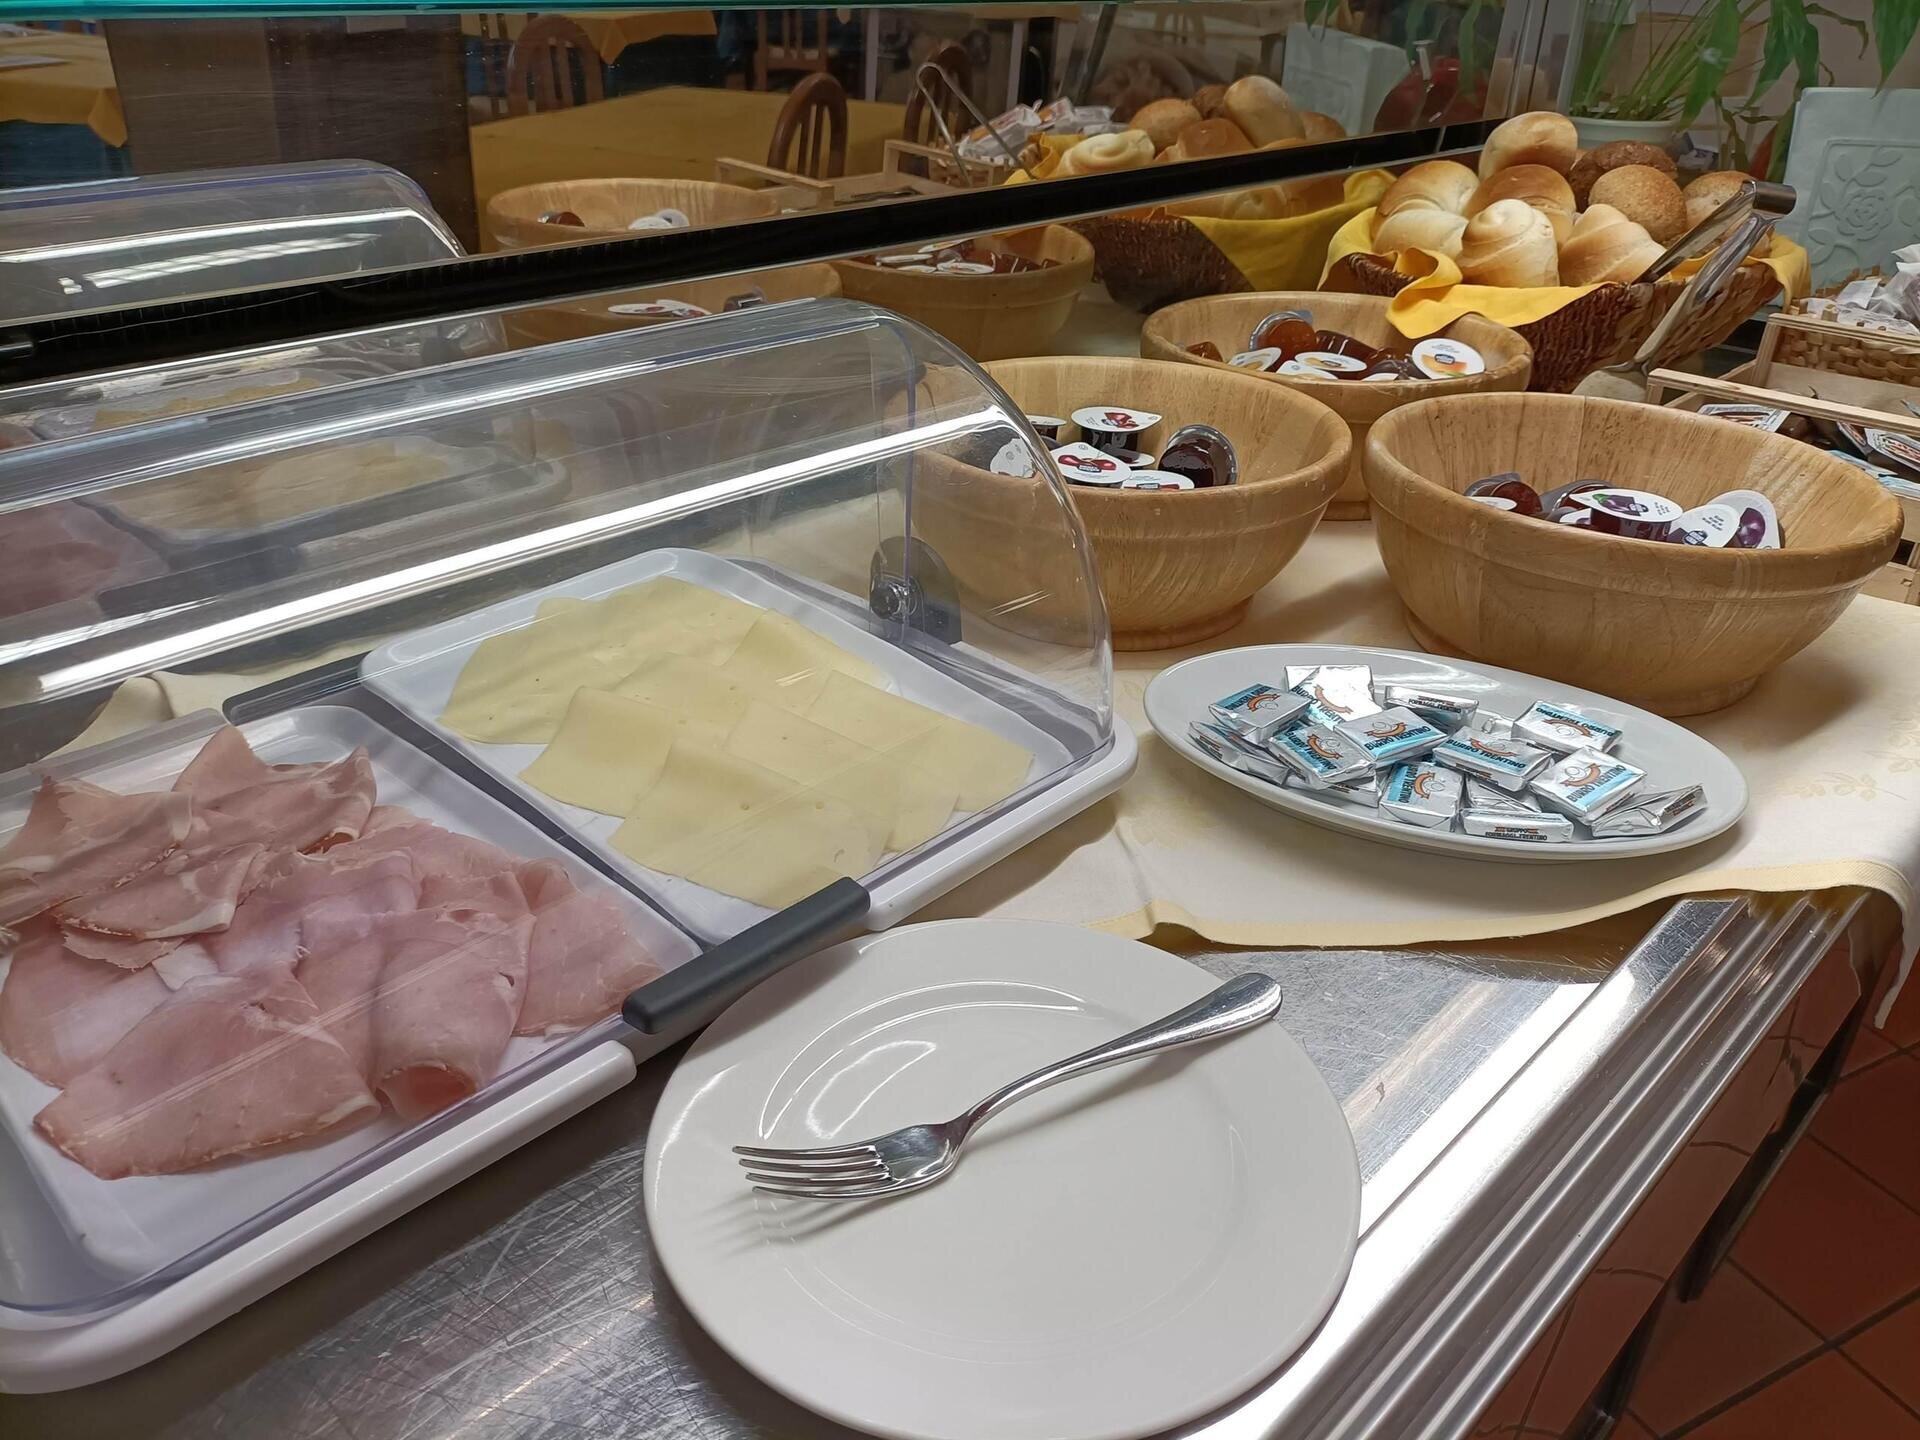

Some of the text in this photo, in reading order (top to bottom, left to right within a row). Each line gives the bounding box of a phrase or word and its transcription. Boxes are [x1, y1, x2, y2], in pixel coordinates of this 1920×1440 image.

[1535, 706, 1581, 726] TRENTINO
[1364, 725, 1432, 752] BURRO TRENTINO
[1445, 738, 1479, 754] BURRO
[1479, 749, 1527, 769] TRENTINO
[1566, 784, 1596, 803] BURRO
[1594, 764, 1627, 789] TRENTINO
